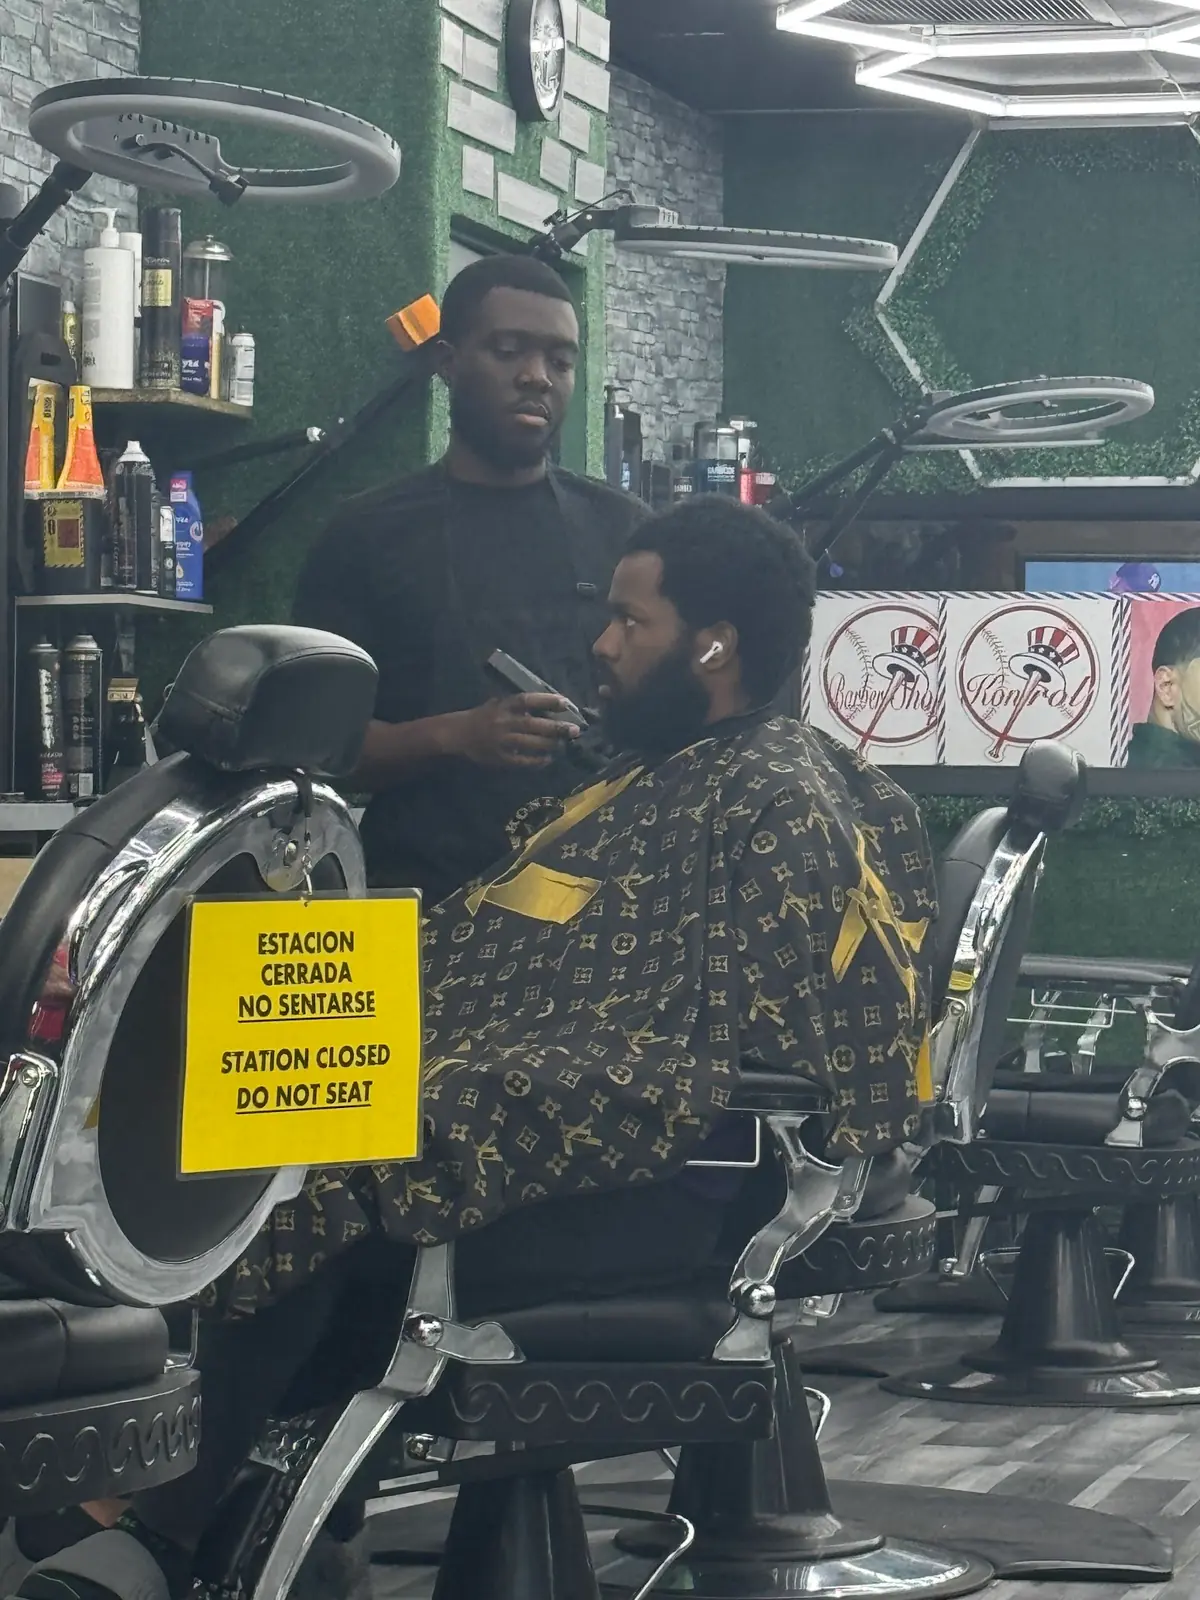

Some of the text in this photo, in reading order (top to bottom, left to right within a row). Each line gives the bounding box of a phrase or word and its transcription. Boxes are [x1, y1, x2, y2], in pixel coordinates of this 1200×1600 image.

[258, 931, 354, 955] ESTACION
[261, 962, 352, 986] CERRADA
[238, 990, 375, 1017] NO SENTARSE
[221, 1044, 390, 1074] STATION CLOSED
[237, 1081, 372, 1109] DO NOT SEAT
